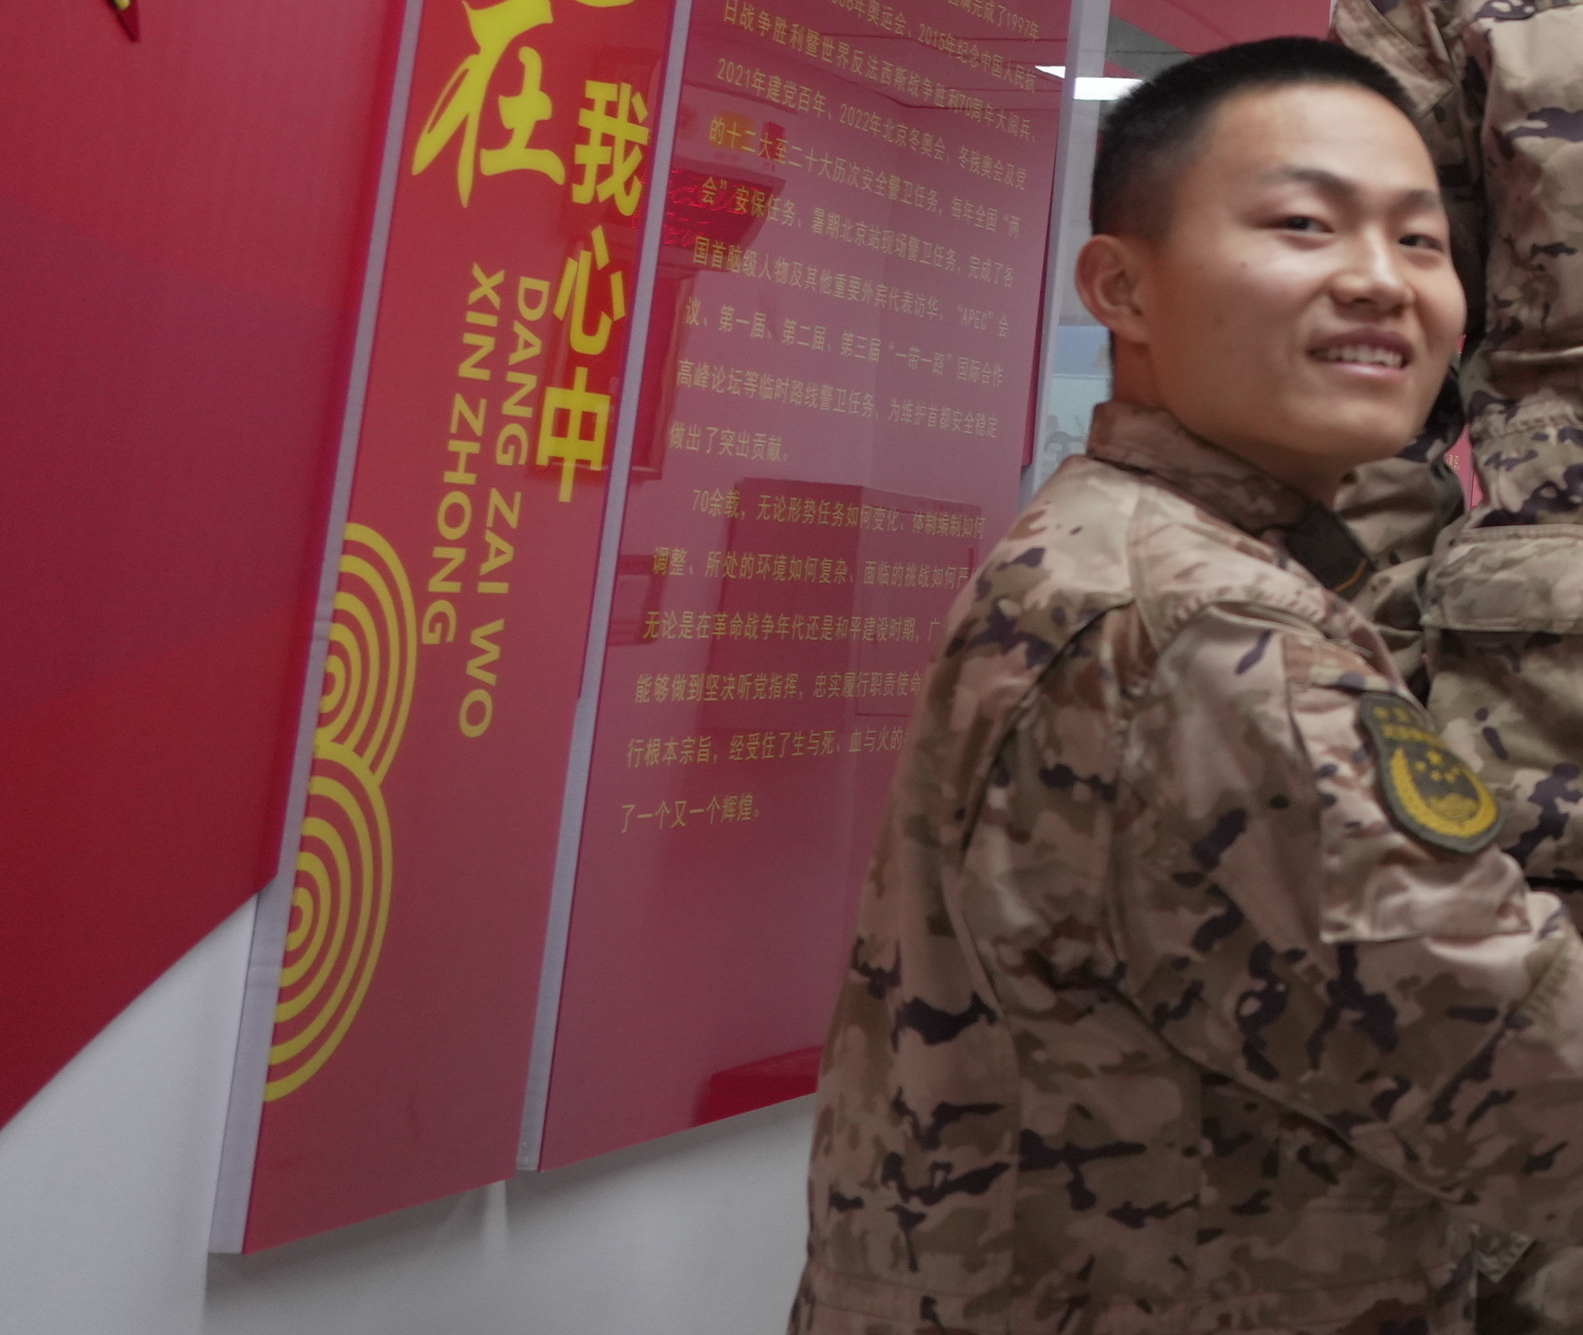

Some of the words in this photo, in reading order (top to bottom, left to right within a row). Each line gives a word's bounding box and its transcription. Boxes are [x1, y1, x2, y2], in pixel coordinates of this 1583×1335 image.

[458, 261, 506, 382] XIN
[534, 78, 652, 504] 我心中
[495, 275, 551, 466] DANG
[669, 420, 790, 462] 做出了突出贡献。
[421, 393, 487, 645] ZHONG
[477, 487, 521, 595] ZAI
[652, 546, 978, 590] 调整、所处的环境如何复杂、面临的挑战如何严
[458, 618, 505, 739] WO
[643, 611, 945, 644] 无论是在革命战争年代还是和平建设时期，广
[626, 726, 907, 769] 行根本宗旨，经受住了生与死、血与火的
[620, 792, 760, 834] 了一个又一个辉煌。
